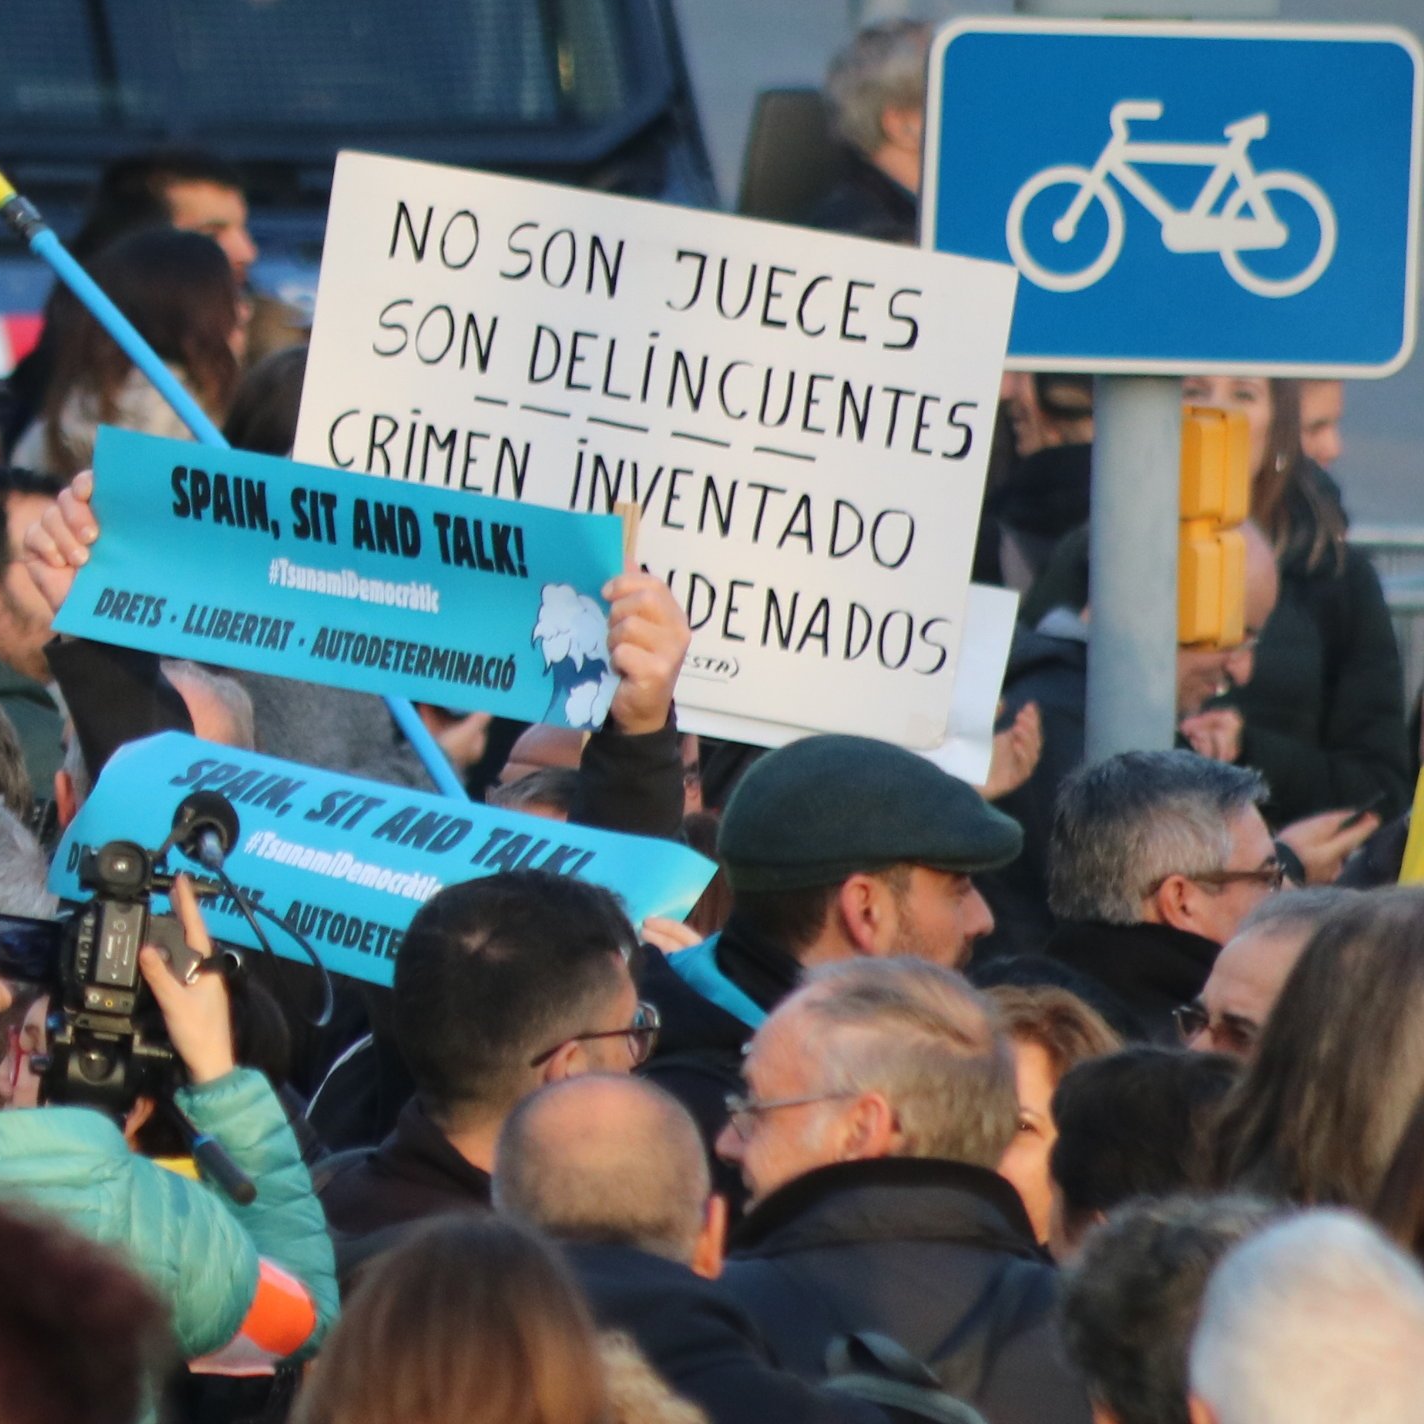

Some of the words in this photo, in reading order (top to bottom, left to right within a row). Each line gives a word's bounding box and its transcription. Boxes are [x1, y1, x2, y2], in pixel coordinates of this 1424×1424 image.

[389, 200, 480, 271] NO
[500, 222, 625, 299] SON
[665, 248, 923, 351] JUECES
[372, 299, 499, 374] SON
[171, 465, 281, 540] SPAIN,
[290, 487, 338, 545] SIT
[352, 498, 422, 559] AND
[433, 512, 529, 579] TALK!
[92, 587, 168, 628] DRETS
[182, 603, 296, 651] LLIBERTAT
[311, 626, 516, 692] AUTODETERMINACIÓ
[168, 759, 307, 818] SPAIN,
[304, 788, 388, 831] SIT
[371, 805, 474, 854] AND
